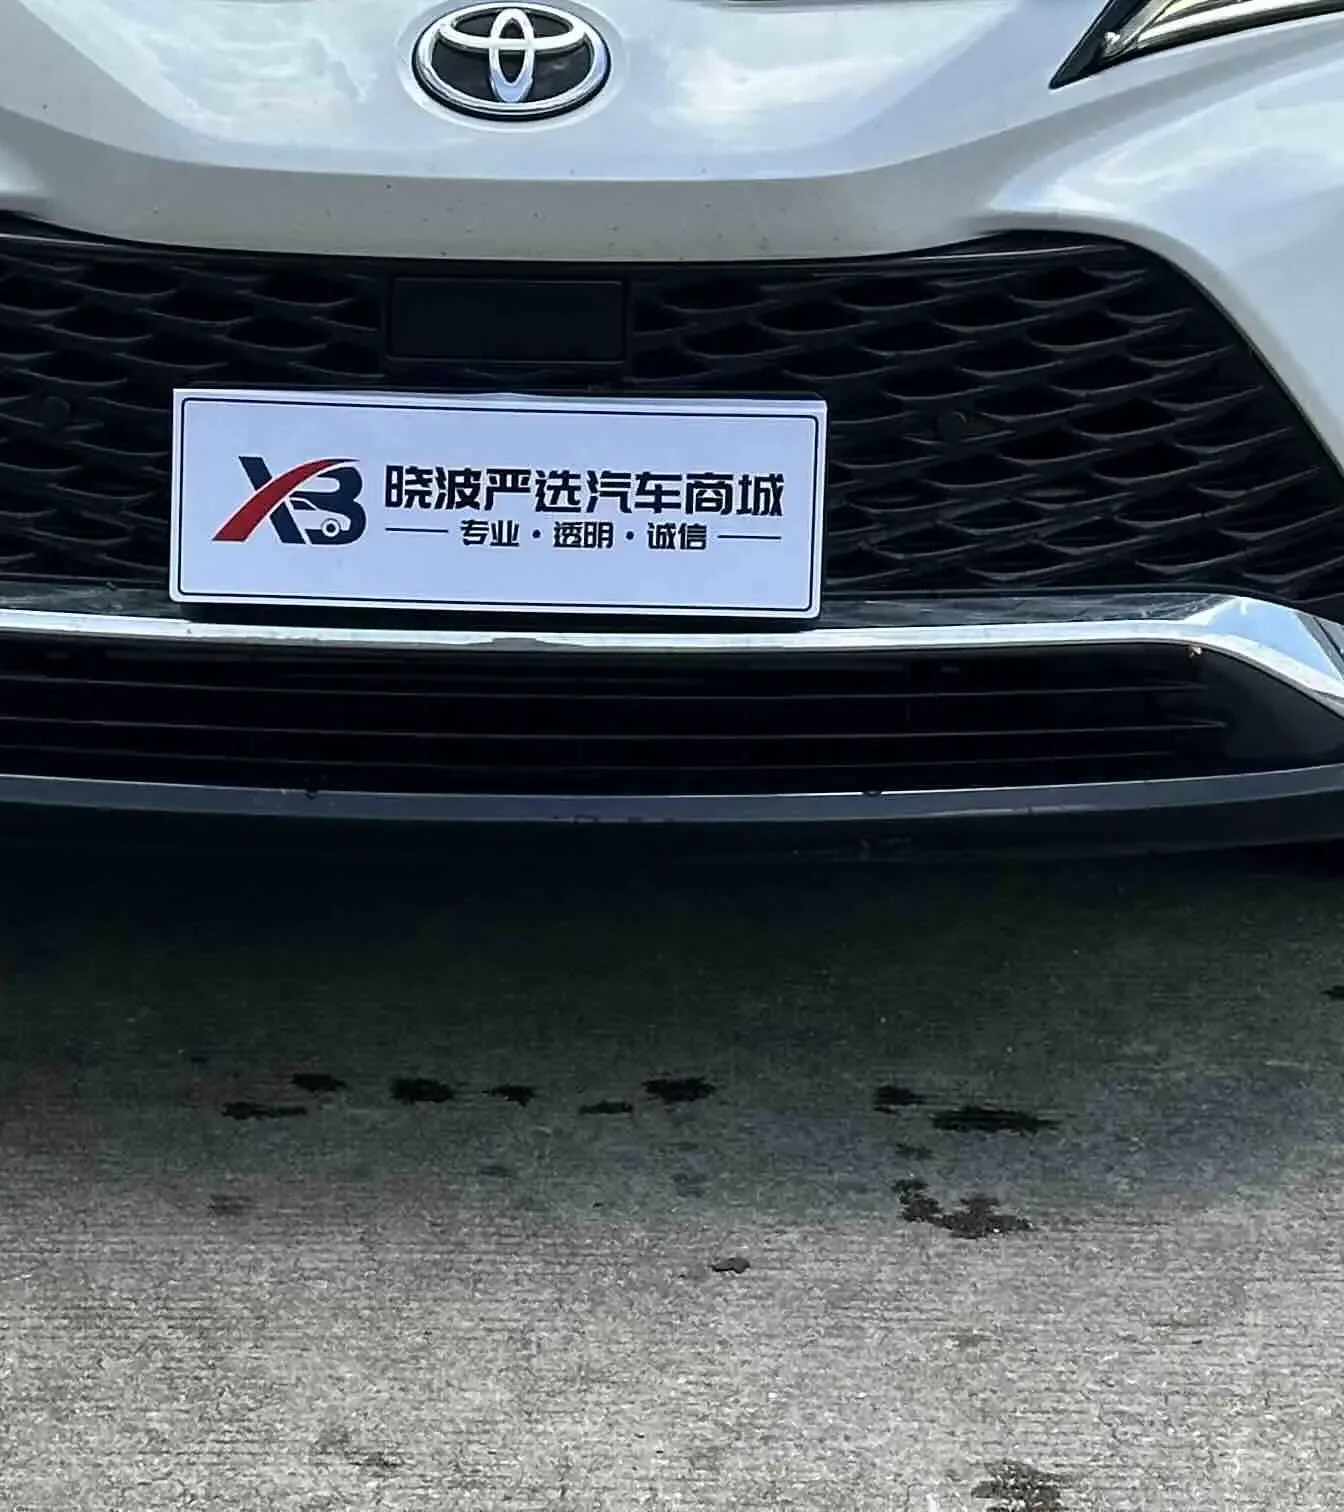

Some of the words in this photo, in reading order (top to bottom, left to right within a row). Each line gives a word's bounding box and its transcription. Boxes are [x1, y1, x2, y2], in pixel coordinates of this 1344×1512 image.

[384, 464, 785, 517] 晓波严选汽车商城
